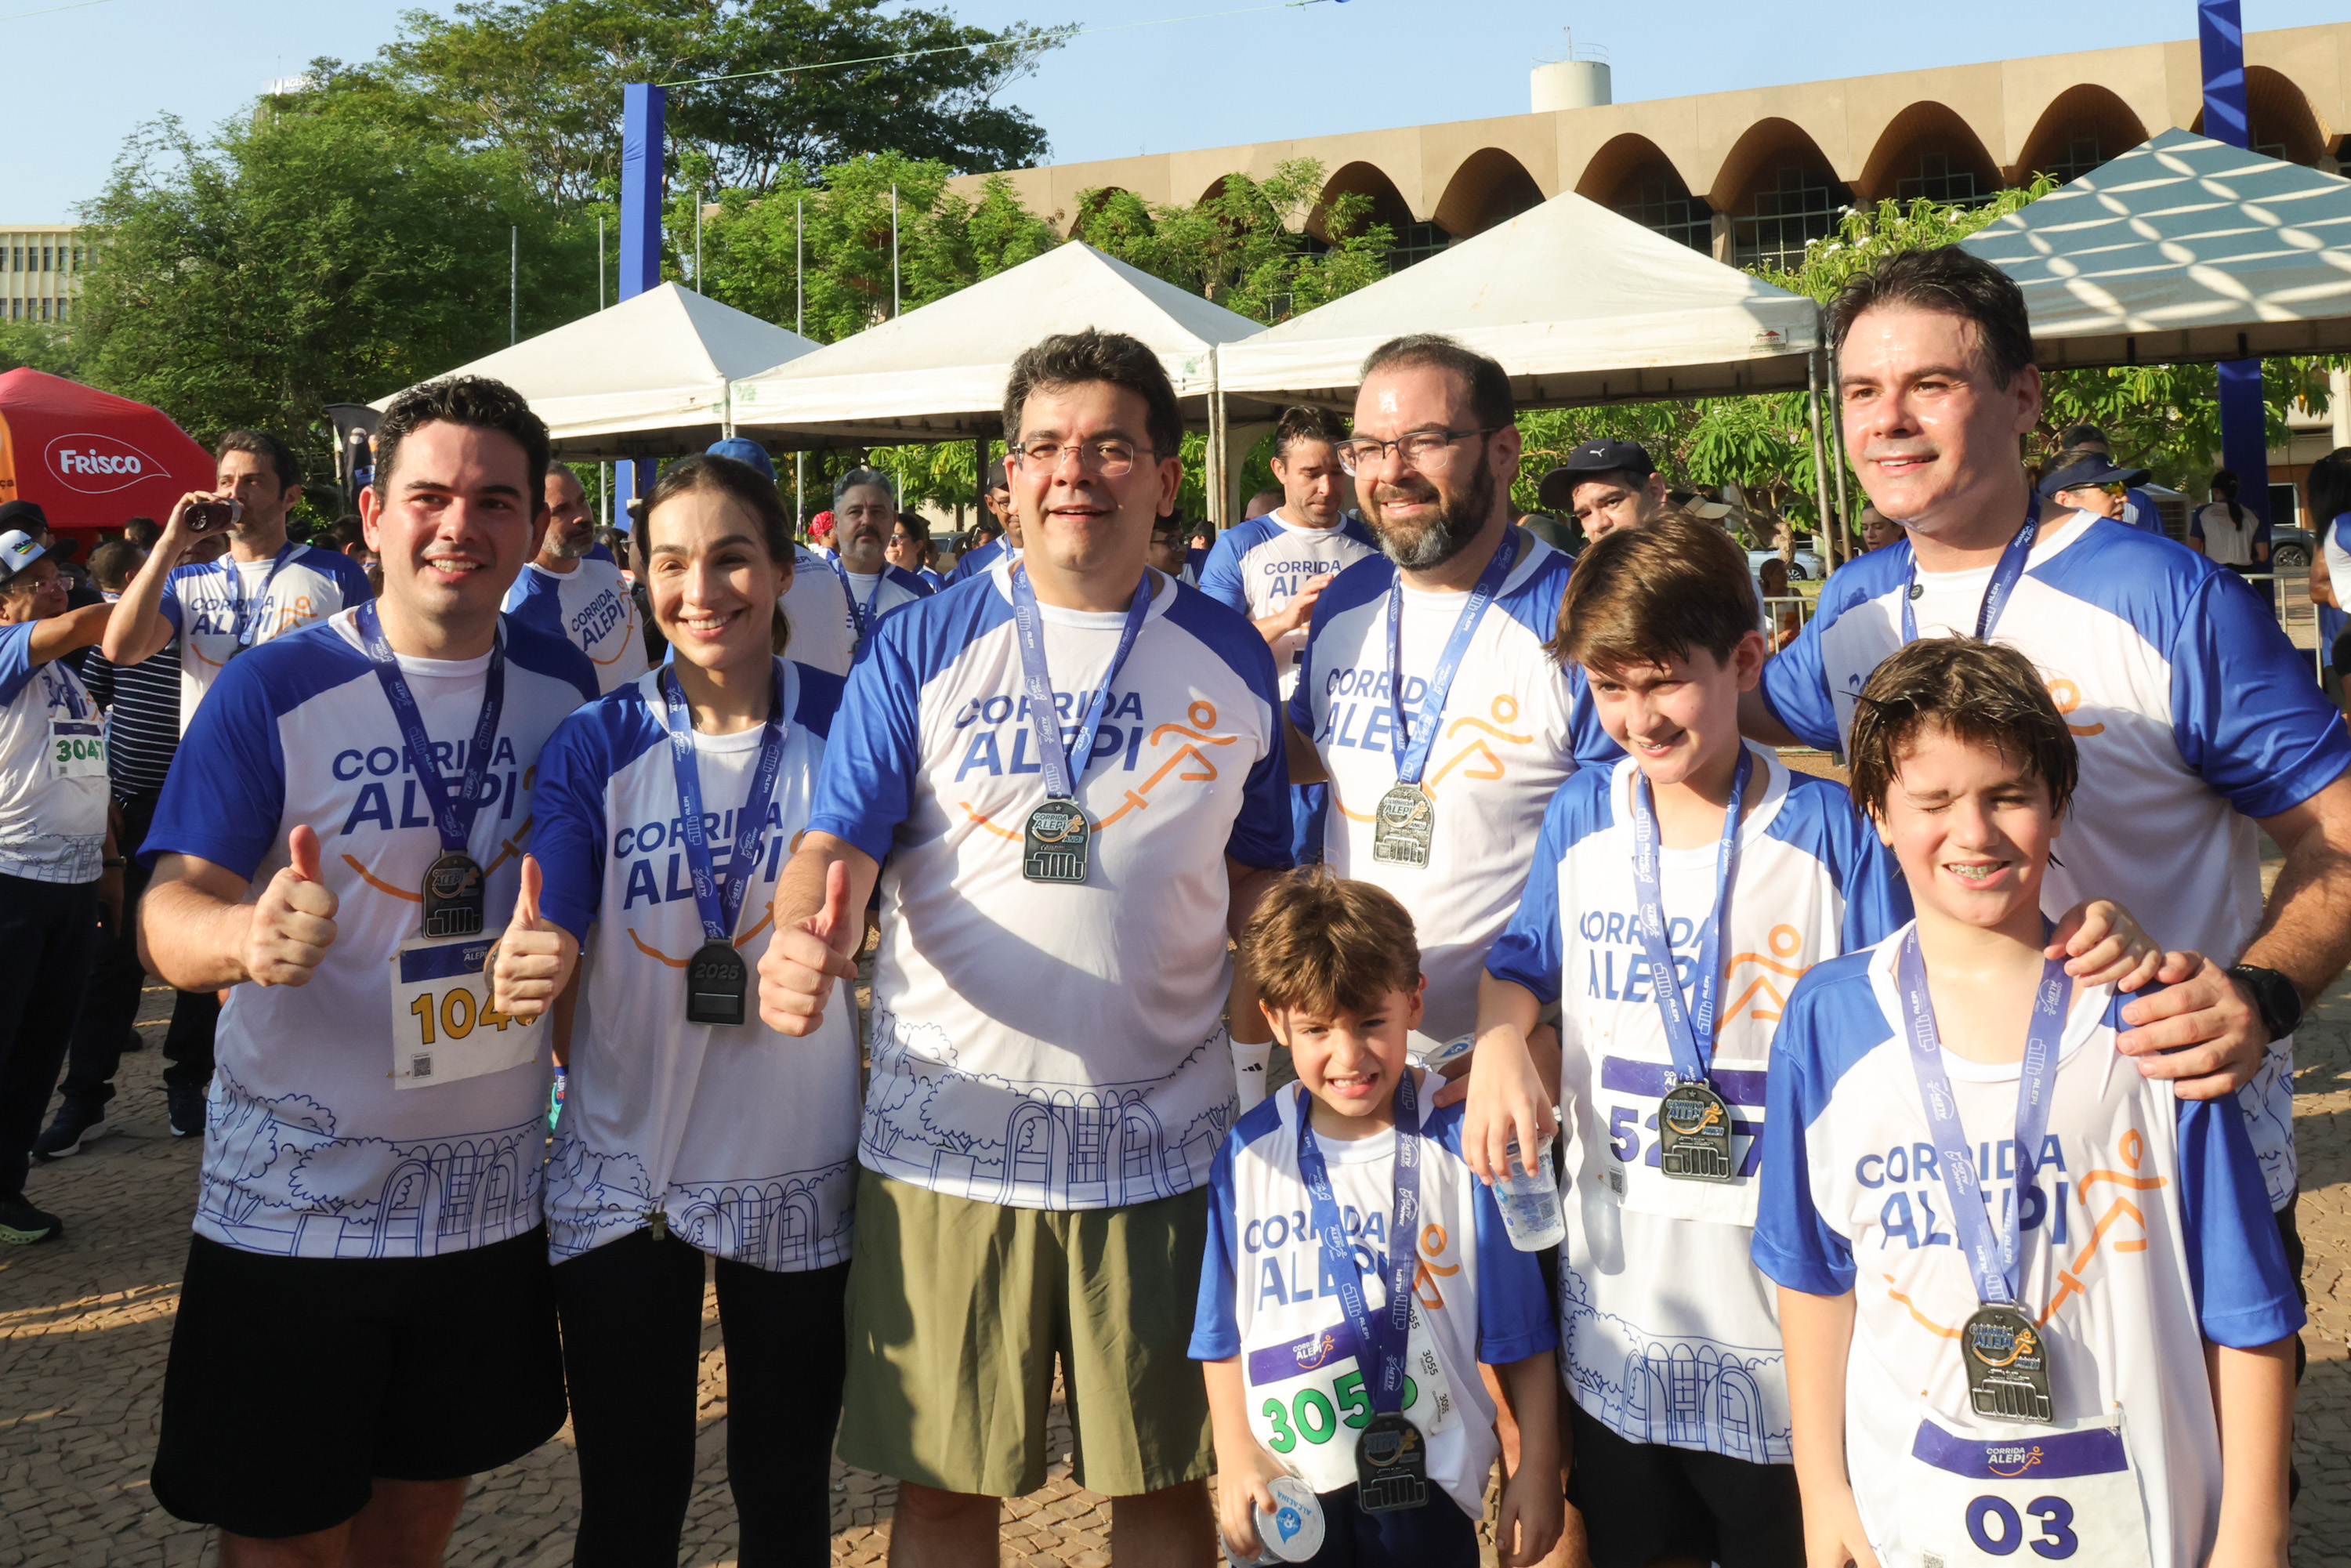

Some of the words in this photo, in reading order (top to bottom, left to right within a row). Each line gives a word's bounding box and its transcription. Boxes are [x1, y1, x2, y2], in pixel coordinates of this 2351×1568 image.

[1264, 559, 1342, 575] CORRIDA
[191, 596, 274, 612] CORRIA
[1987, 582, 2001, 604] ALEPI
[571, 588, 615, 632] CORRIDA
[1463, 612, 1476, 631] ALEPI
[582, 599, 625, 652] ALEPI
[1326, 668, 1447, 712] CORRD
[332, 737, 516, 782] CORIA
[763, 774, 772, 794] ALEPI
[614, 802, 783, 860] CORIA
[1034, 820, 1066, 830] ALEPI
[623, 835, 784, 911] ALEI
[698, 877, 707, 897] ALEPI
[695, 963, 739, 980] 2025
[1588, 949, 1699, 1003] ALEP
[1702, 975, 1711, 999] ALEPI
[2047, 980, 2057, 1004] ALEPI
[1669, 998, 1680, 1023] ALEPI
[1911, 990, 1921, 1014] ALEPI
[411, 987, 538, 1045] 104
[2030, 1077, 2041, 1106] ALEPI
[1668, 1108, 1704, 1119] ALEPI
[1936, 1093, 1948, 1120] ALEPI
[1610, 1106, 1764, 1177] 57
[1855, 1133, 2067, 1189] CORIDA
[1951, 1164, 1965, 1196] AVANÇA
[1959, 1162, 1969, 1186] ALEPI
[1244, 1205, 1386, 1254] CORDA
[1330, 1226, 1341, 1249] ALEPI
[1976, 1245, 1989, 1273] ALEPI
[2004, 1236, 2012, 1263] ALEPI
[1359, 1316, 1370, 1340] ALEPI
[1295, 1343, 1322, 1361] ALEPI
[1973, 1335, 2015, 1349] ALEPI
[1422, 1349, 1439, 1376] 3055
[1262, 1368, 1418, 1455] 305
[1986, 1447, 2026, 1455] CORRIDA
[1987, 1454, 2026, 1465] ALEPI
[1277, 1490, 1312, 1515] ALCALINA
[1965, 1494, 2078, 1560] 03
